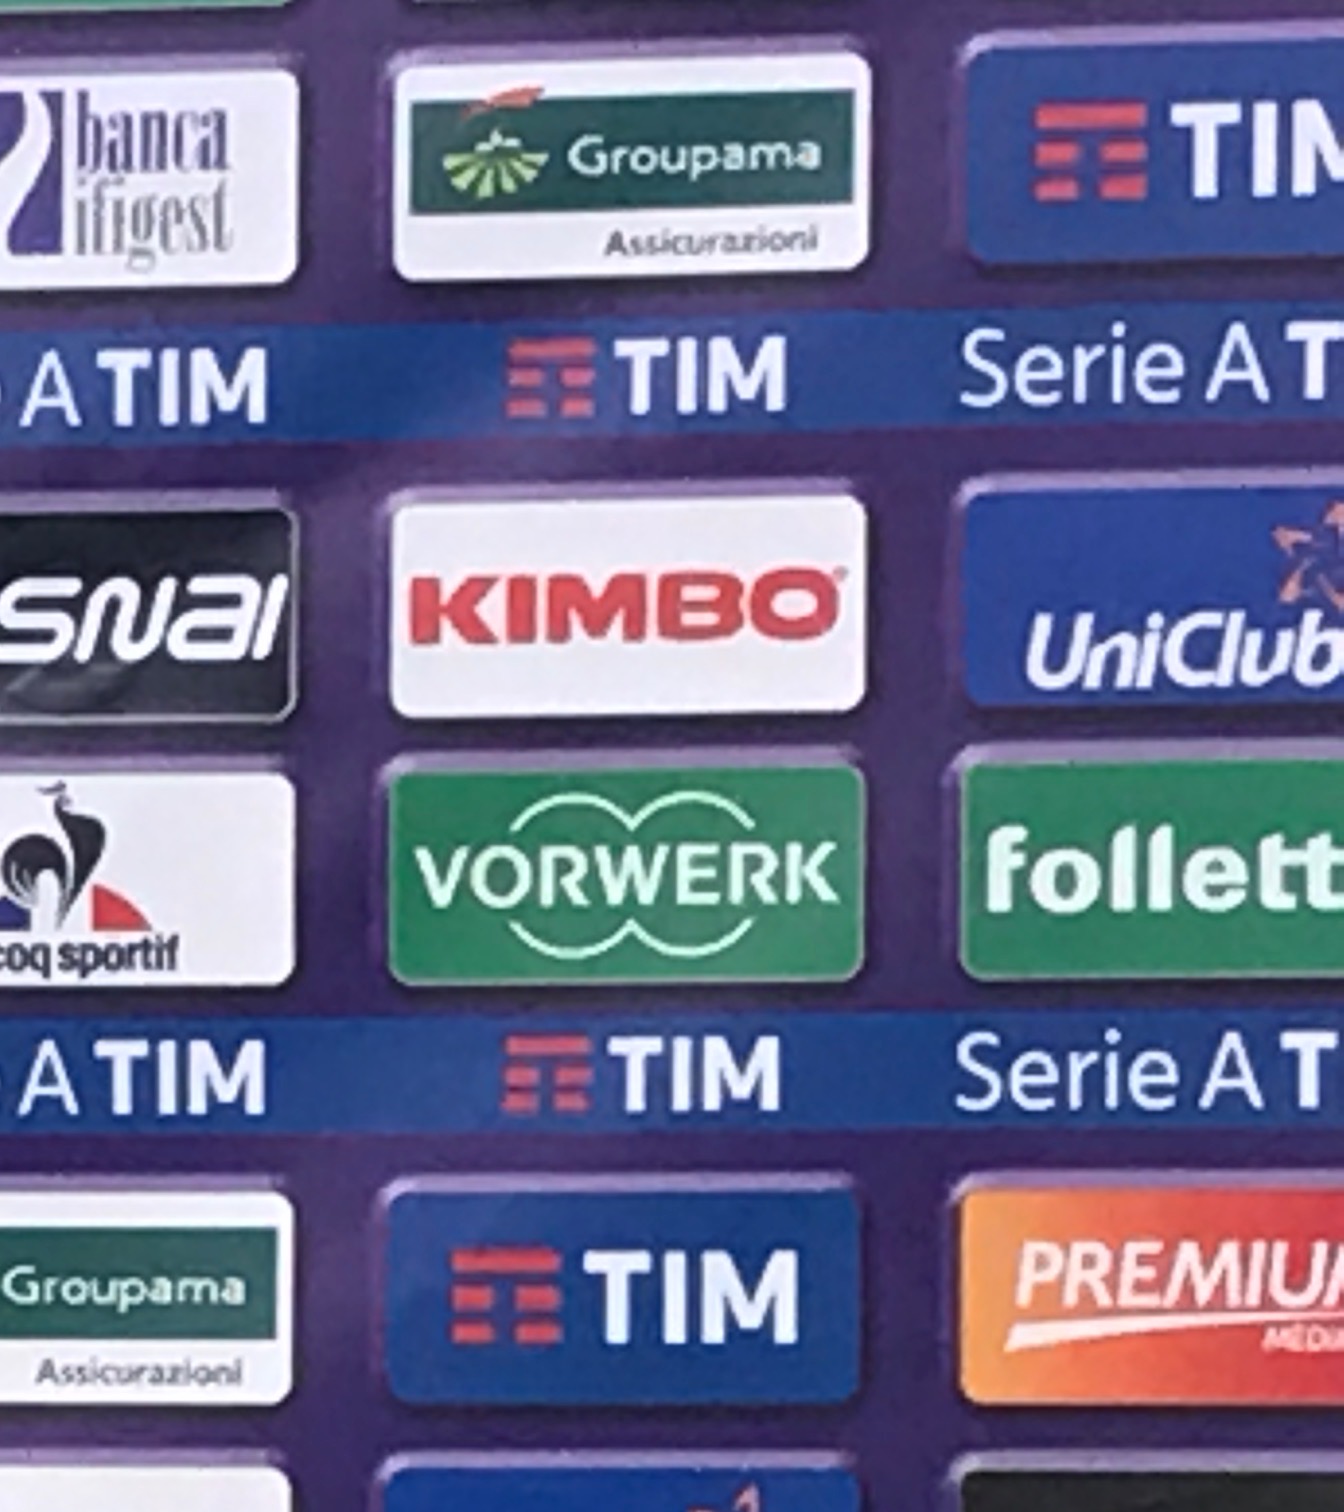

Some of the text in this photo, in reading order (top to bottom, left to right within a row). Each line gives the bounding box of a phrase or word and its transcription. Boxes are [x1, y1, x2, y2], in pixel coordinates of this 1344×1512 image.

[74, 89, 230, 175] banca
[567, 135, 822, 186] Groupama
[604, 223, 818, 259] Assicurazioni
[20, 350, 82, 428] A
[96, 348, 266, 426] TIM
[614, 335, 786, 414] TIM
[960, 321, 1185, 408] Serie
[1205, 321, 1270, 403] A
[1024, 608, 1344, 691] UniClub
[415, 841, 839, 909] VORWERK
[986, 822, 1344, 914] follett
[57, 934, 179, 979] sportif
[18, 1038, 79, 1116] A
[93, 1038, 266, 1116] TIM
[608, 1035, 780, 1113] TIM
[955, 1028, 1179, 1113] Serie
[1198, 1030, 1265, 1110] A
[1, 1265, 246, 1315] Groupama
[583, 1250, 799, 1344] TIM
[1015, 1239, 1344, 1308] PREMIU
[33, 1357, 244, 1388] Assicurazioni
